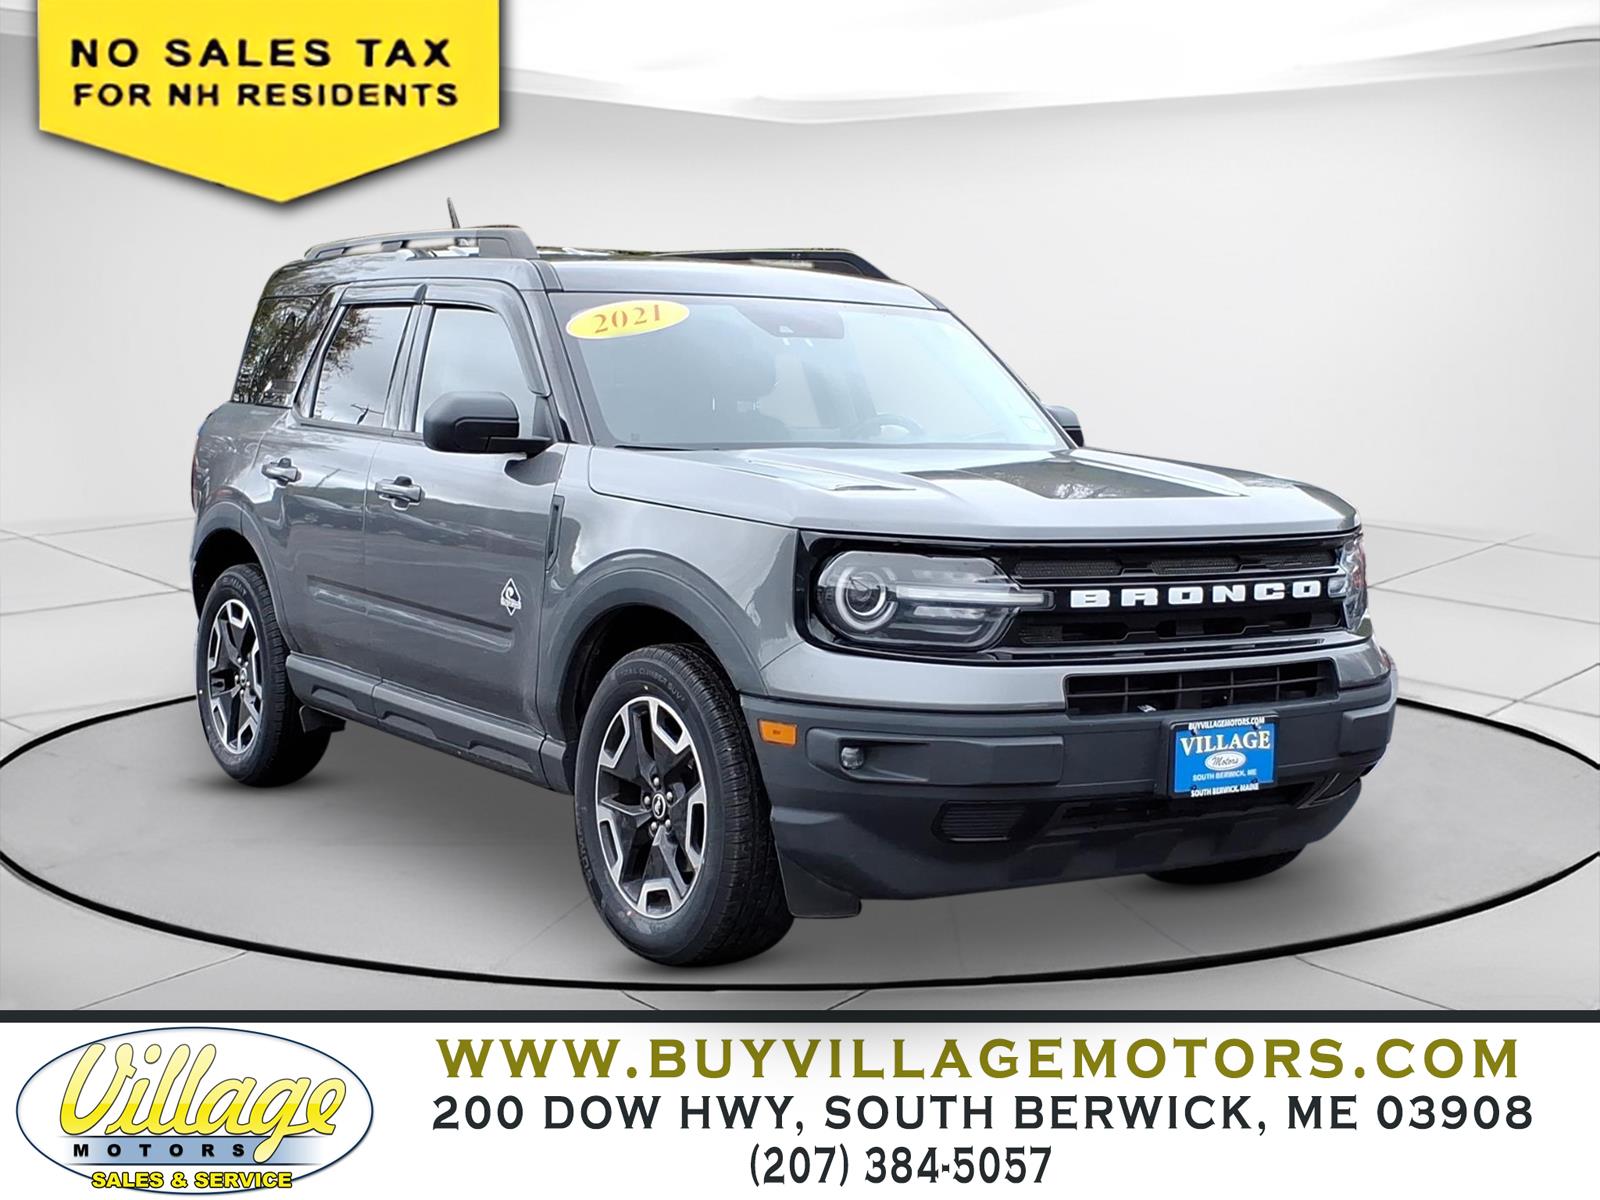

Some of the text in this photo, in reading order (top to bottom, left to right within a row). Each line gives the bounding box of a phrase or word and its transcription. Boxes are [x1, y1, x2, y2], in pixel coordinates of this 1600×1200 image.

[593, 304, 660, 333] 2021
[1070, 580, 1321, 608] BRONCO
[1180, 730, 1271, 757] VILLAGE
[1192, 773, 1215, 782] SOUTH
[1190, 787, 1212, 798] SOUTH
